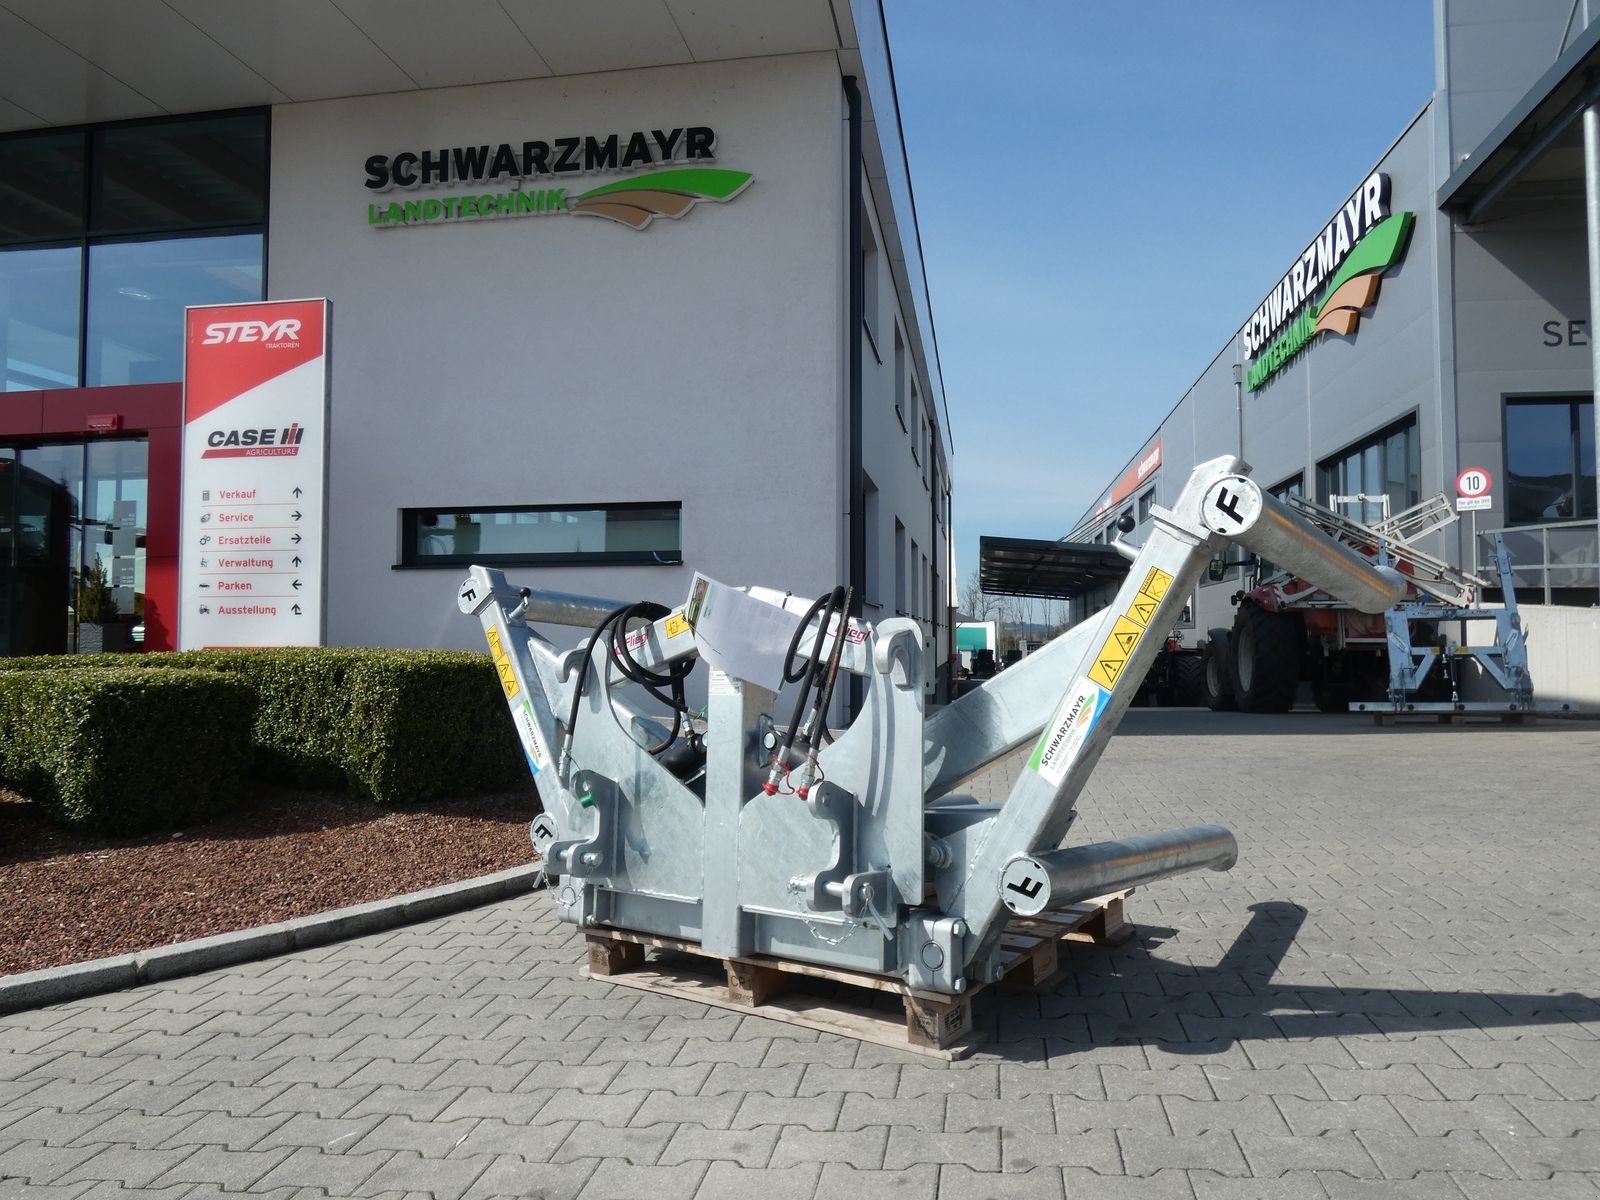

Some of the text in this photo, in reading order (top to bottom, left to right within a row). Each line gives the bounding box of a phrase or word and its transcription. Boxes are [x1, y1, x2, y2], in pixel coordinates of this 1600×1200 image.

[364, 126, 716, 189] SCHWARZMAYR
[368, 188, 568, 225] LANDTECHNIK
[1244, 172, 1390, 361] SCHWARZMAYR
[202, 319, 301, 345] STEYR
[265, 342, 300, 350] TRAKTOREN
[207, 428, 277, 447] CASE
[245, 447, 297, 456] AGRICULTURE
[1465, 475, 1480, 491] 10
[219, 489, 256, 499] Verkauf
[1215, 486, 1244, 525] F
[218, 513, 254, 522] Service
[218, 535, 272, 545] Ersatzteile
[218, 558, 274, 568] Verwaltung
[218, 581, 252, 591] Parken
[461, 588, 477, 602] F
[218, 605, 277, 616] Ausstellung
[1041, 694, 1087, 767] SCHWARZMAYR
[1006, 876, 1044, 900] F
